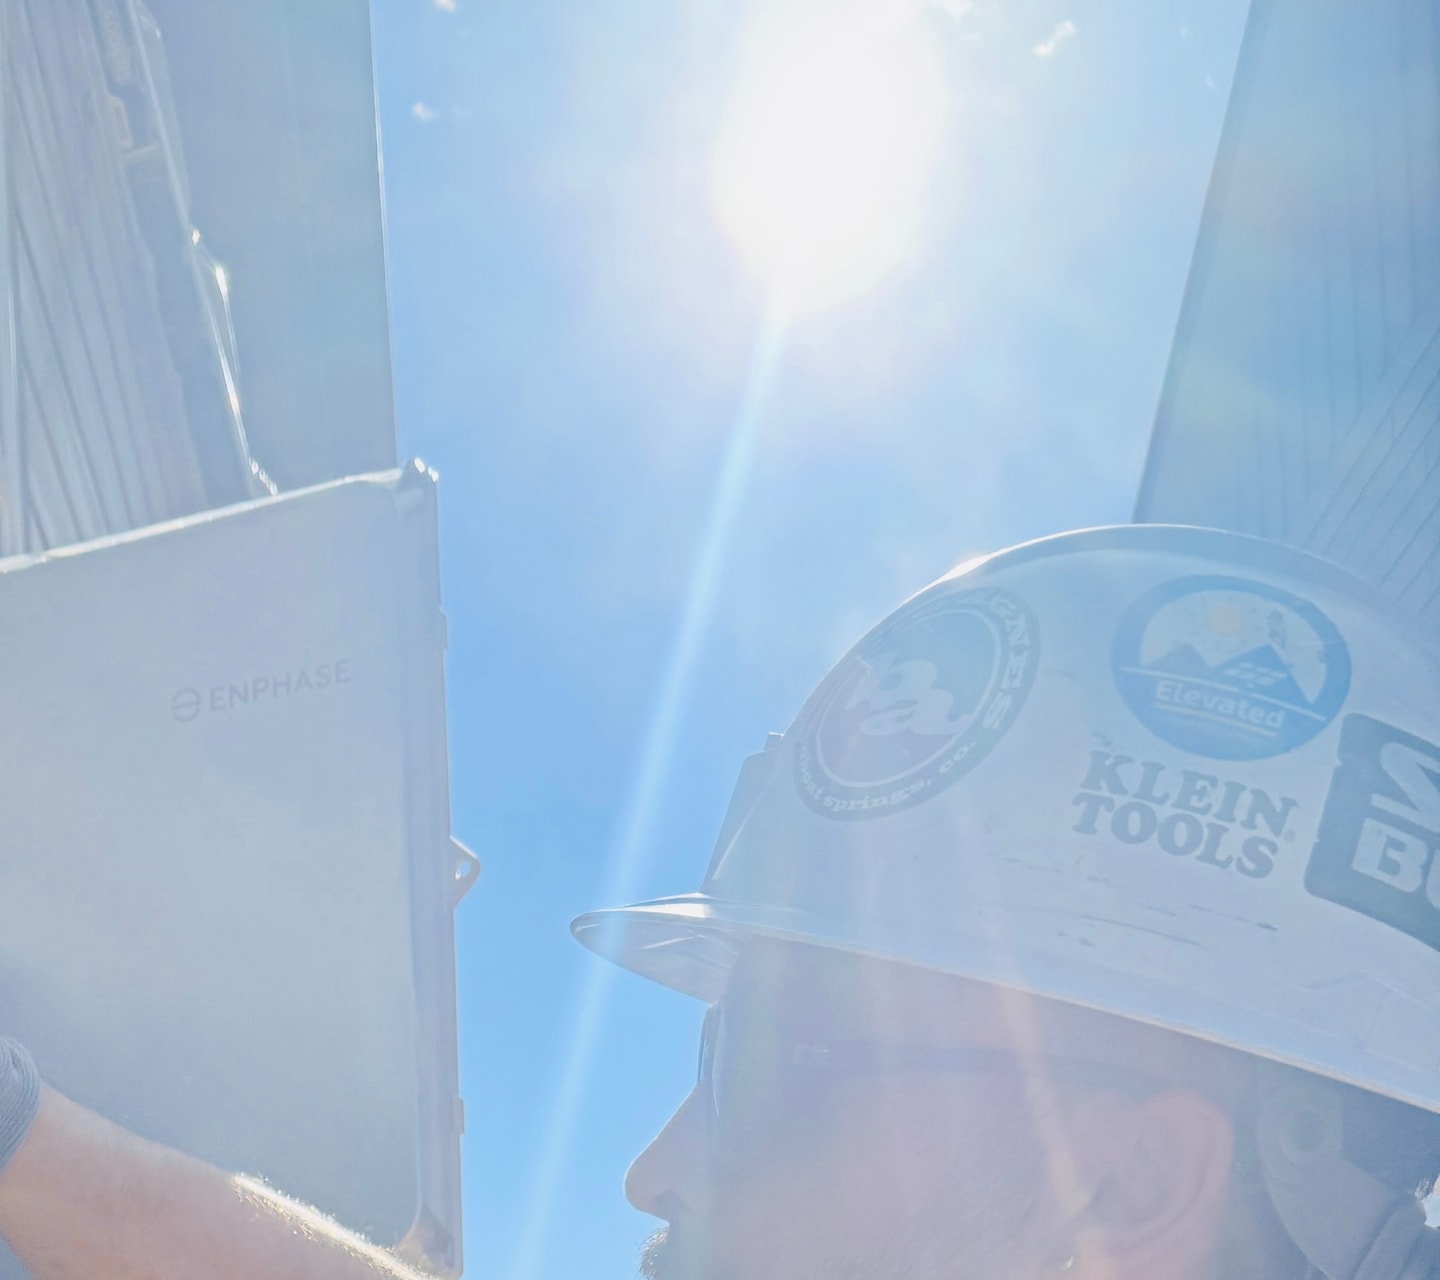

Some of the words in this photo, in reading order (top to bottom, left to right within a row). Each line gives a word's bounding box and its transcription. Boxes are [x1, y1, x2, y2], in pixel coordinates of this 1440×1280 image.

[208, 658, 354, 713] ENPHASE
[1154, 679, 1285, 729] Elevated
[1081, 750, 1299, 838] KLEIN
[1072, 792, 1278, 879] TOOLS
